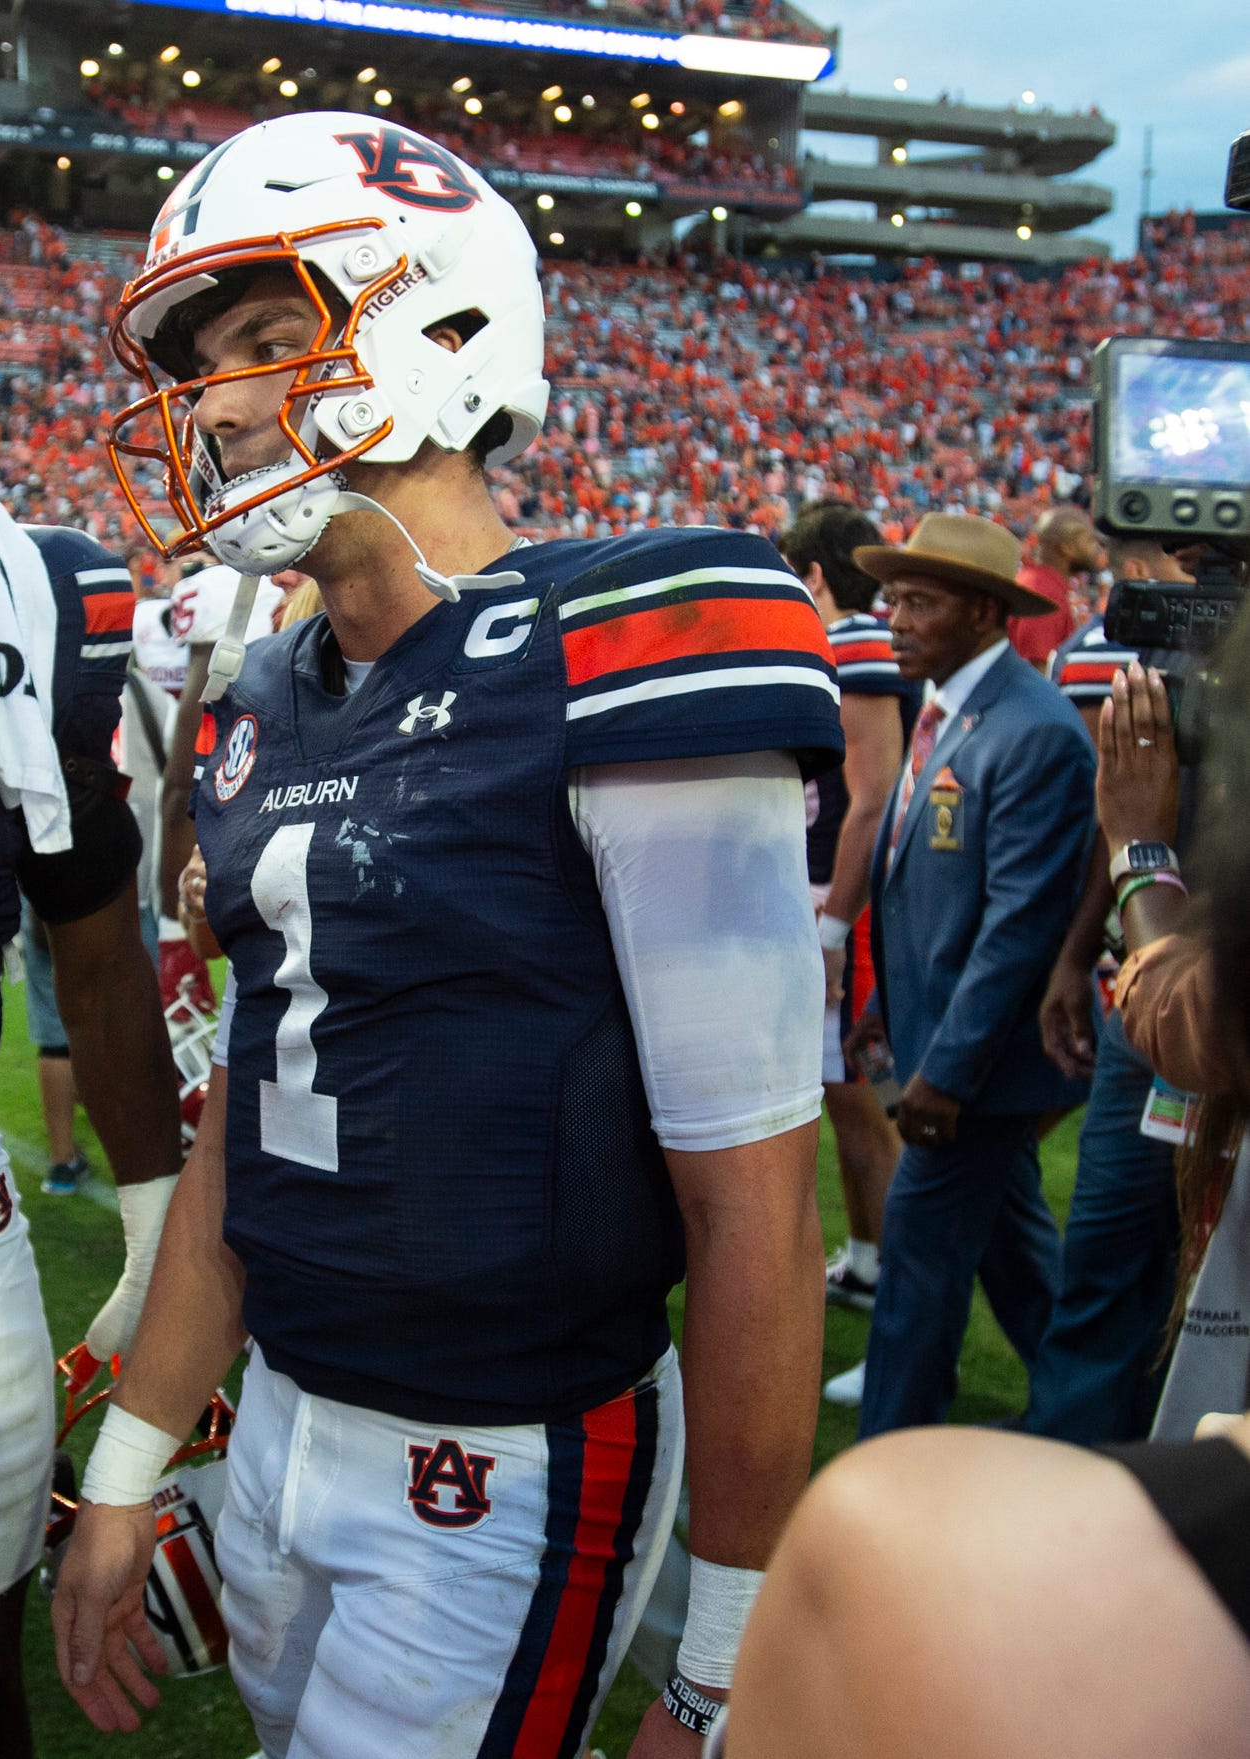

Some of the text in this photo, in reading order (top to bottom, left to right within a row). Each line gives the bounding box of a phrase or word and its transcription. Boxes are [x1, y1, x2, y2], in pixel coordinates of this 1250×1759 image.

[361, 262, 428, 321] TIGERS
[463, 597, 540, 659] C
[225, 719, 254, 779] SEC
[259, 776, 359, 814] AUBURN
[250, 821, 339, 1173] 1
[679, 1707, 697, 1730] TO
